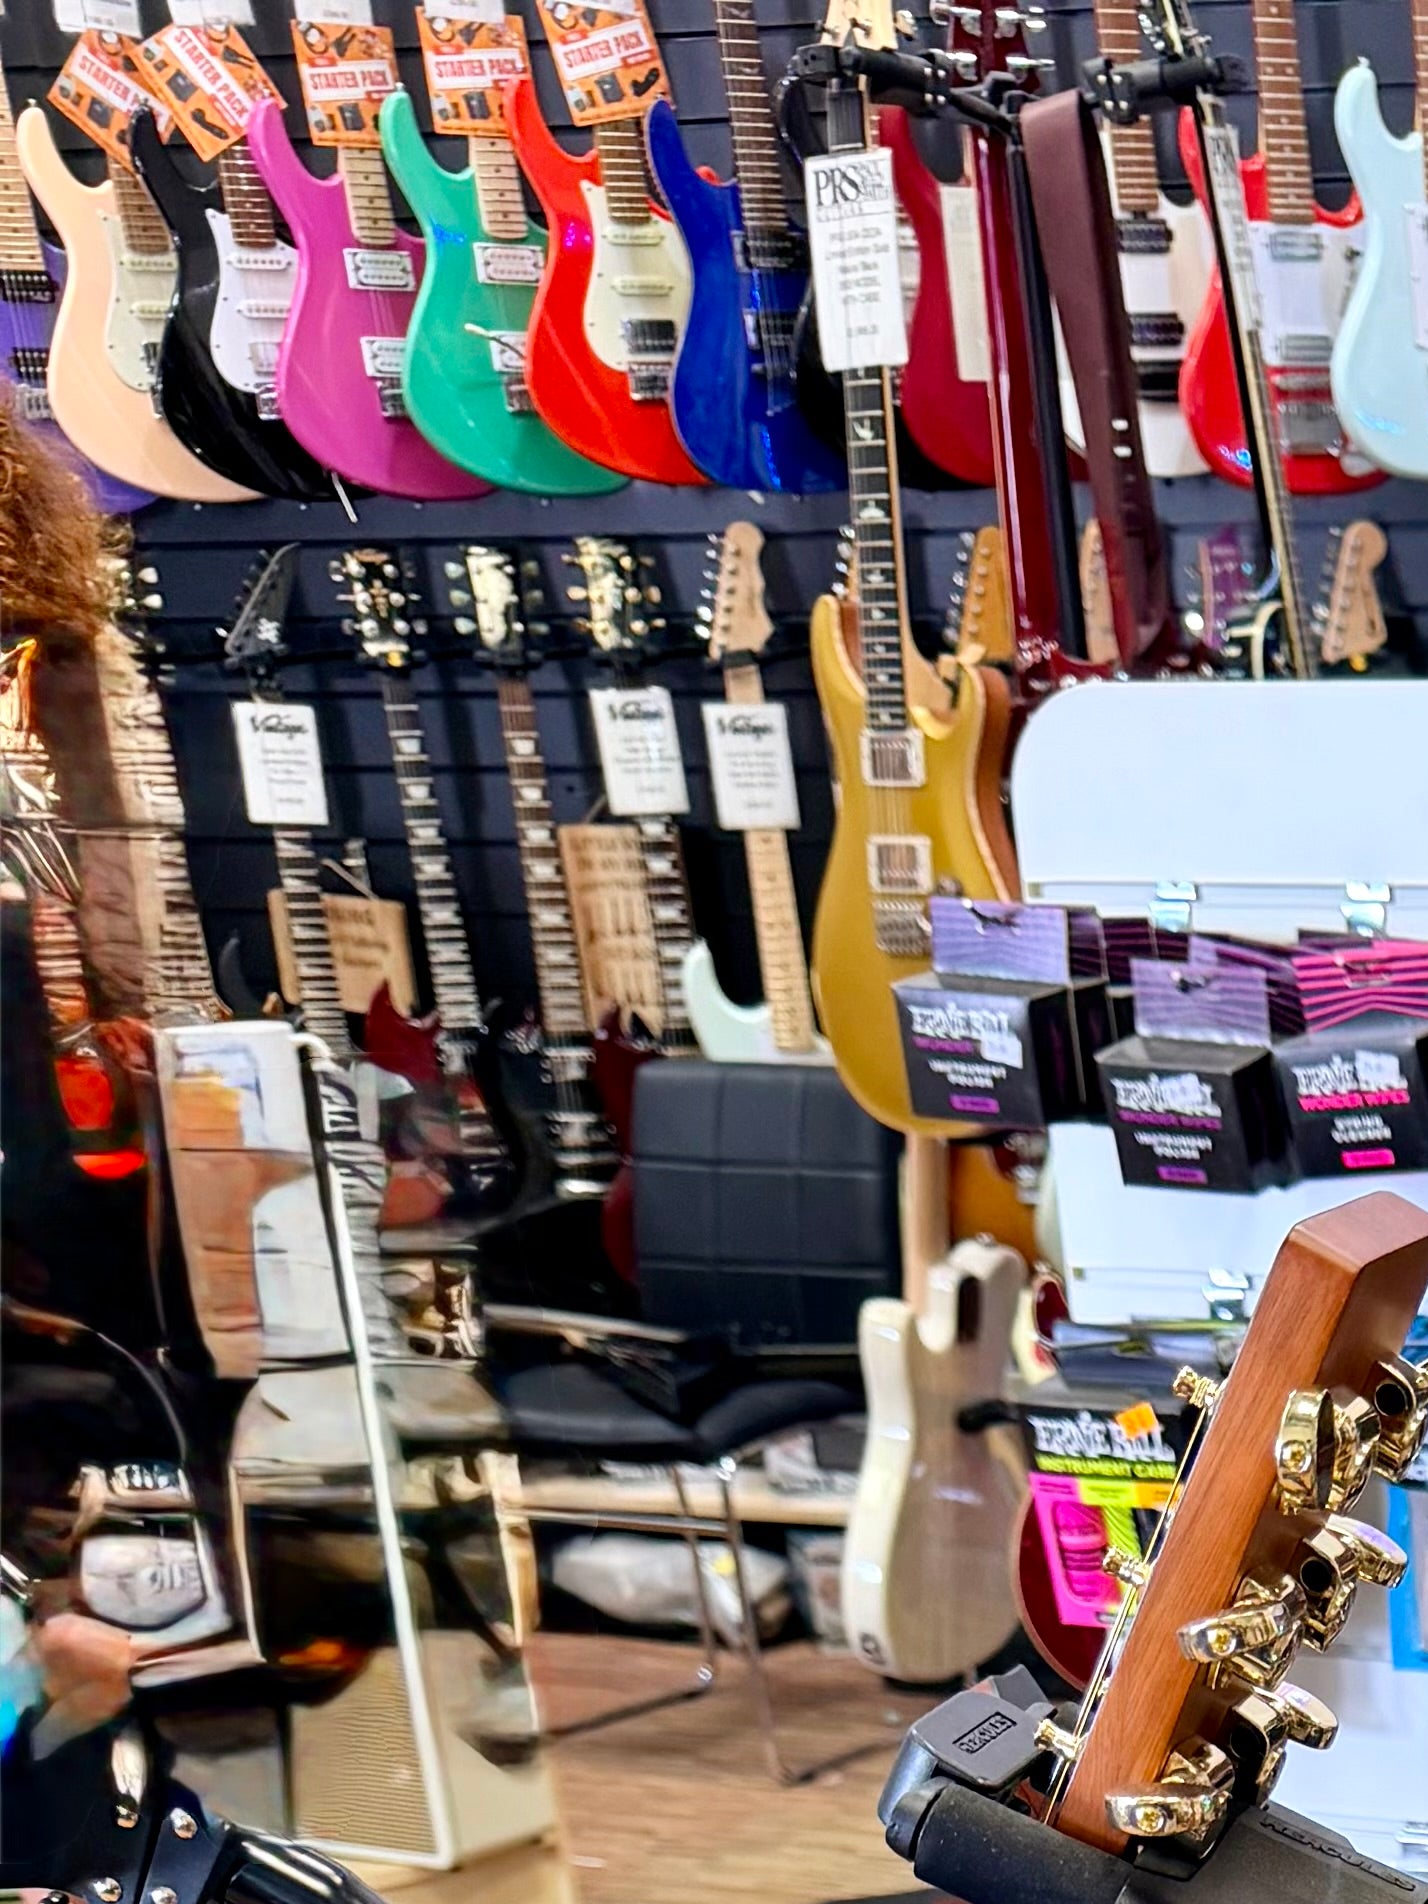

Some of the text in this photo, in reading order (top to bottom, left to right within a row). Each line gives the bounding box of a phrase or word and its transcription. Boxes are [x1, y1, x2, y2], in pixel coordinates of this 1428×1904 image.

[563, 29, 646, 69] STARTER PACK
[308, 66, 390, 89] STARTER PACK
[433, 59, 484, 79] STARTER
